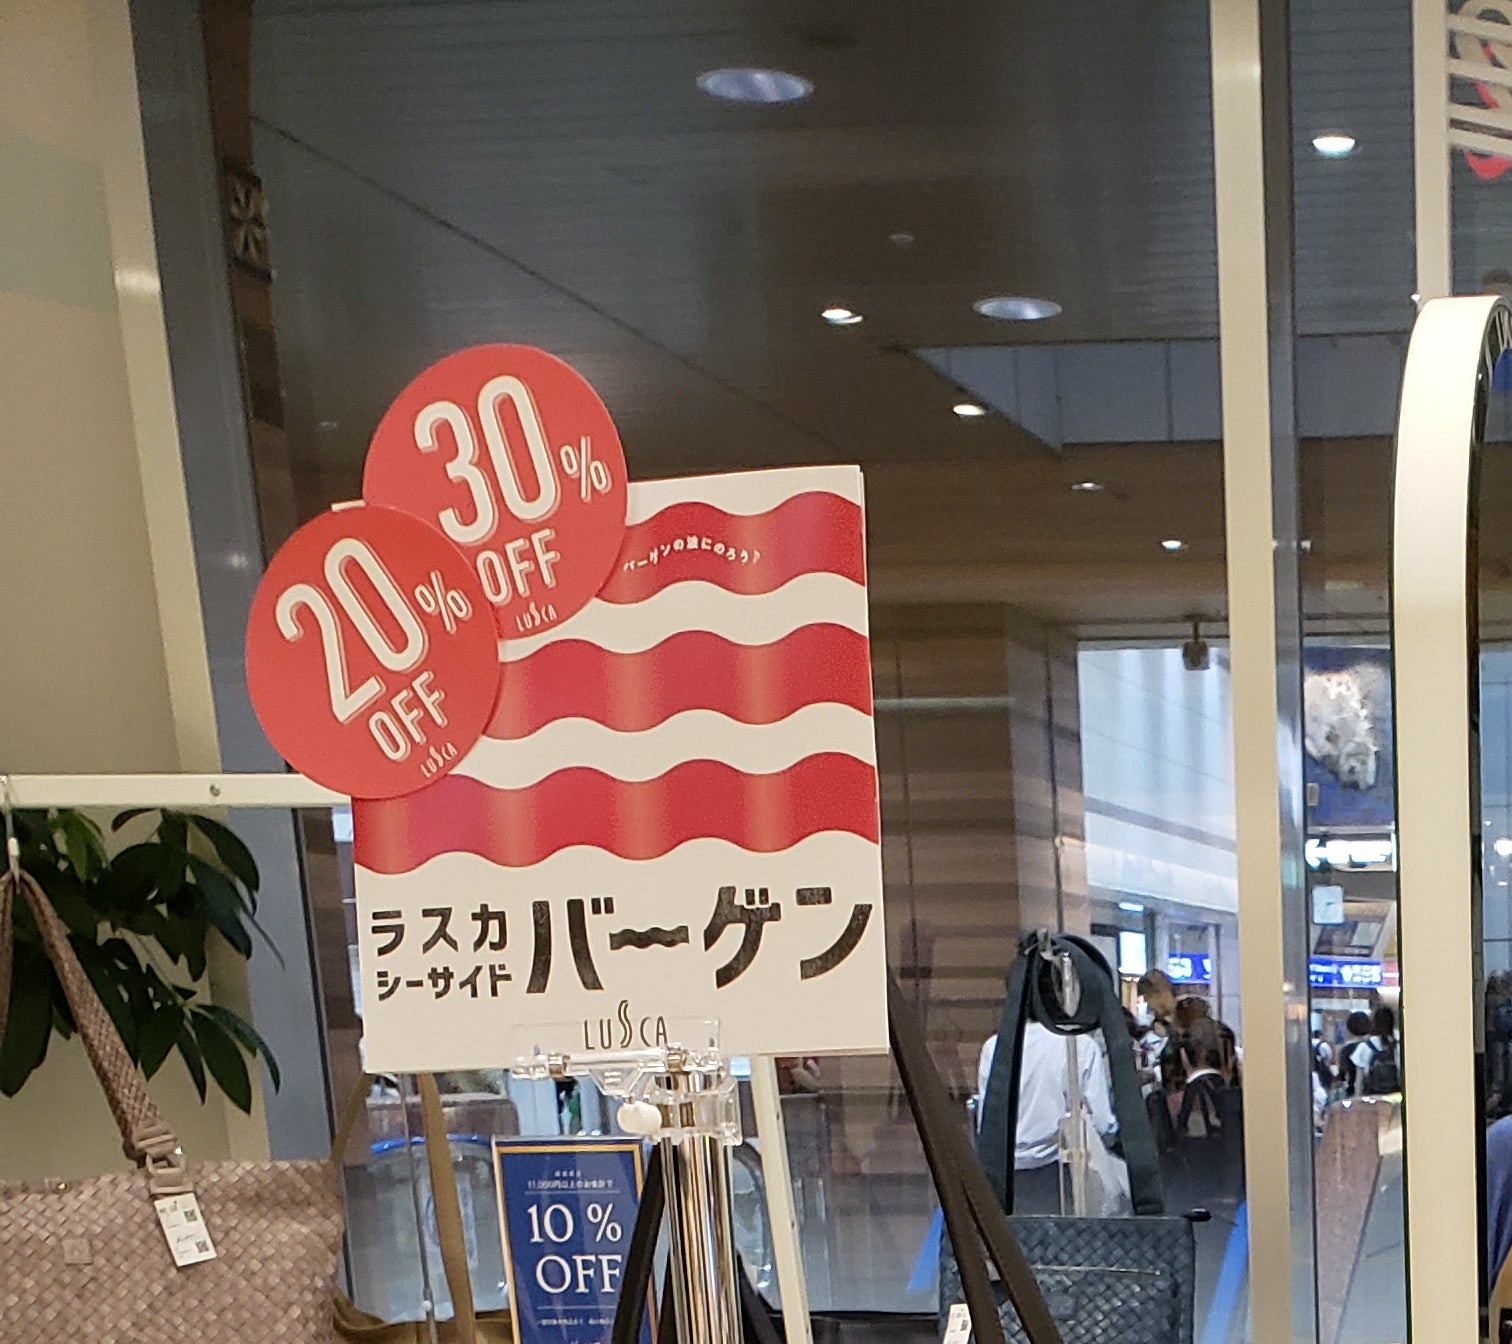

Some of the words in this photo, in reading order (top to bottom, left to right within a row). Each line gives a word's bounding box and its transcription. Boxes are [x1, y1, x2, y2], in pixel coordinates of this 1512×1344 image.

[475, 527, 561, 606] OFF
[515, 602, 557, 632] LUSCA
[367, 670, 446, 764] OFF
[420, 742, 459, 778] LUSCA
[370, 904, 508, 957] ラスカ
[526, 886, 873, 994] バーゲン
[377, 963, 512, 1000] シーサイド
[583, 1000, 668, 1051] LUSCA
[536, 1254, 622, 1294] OFF
